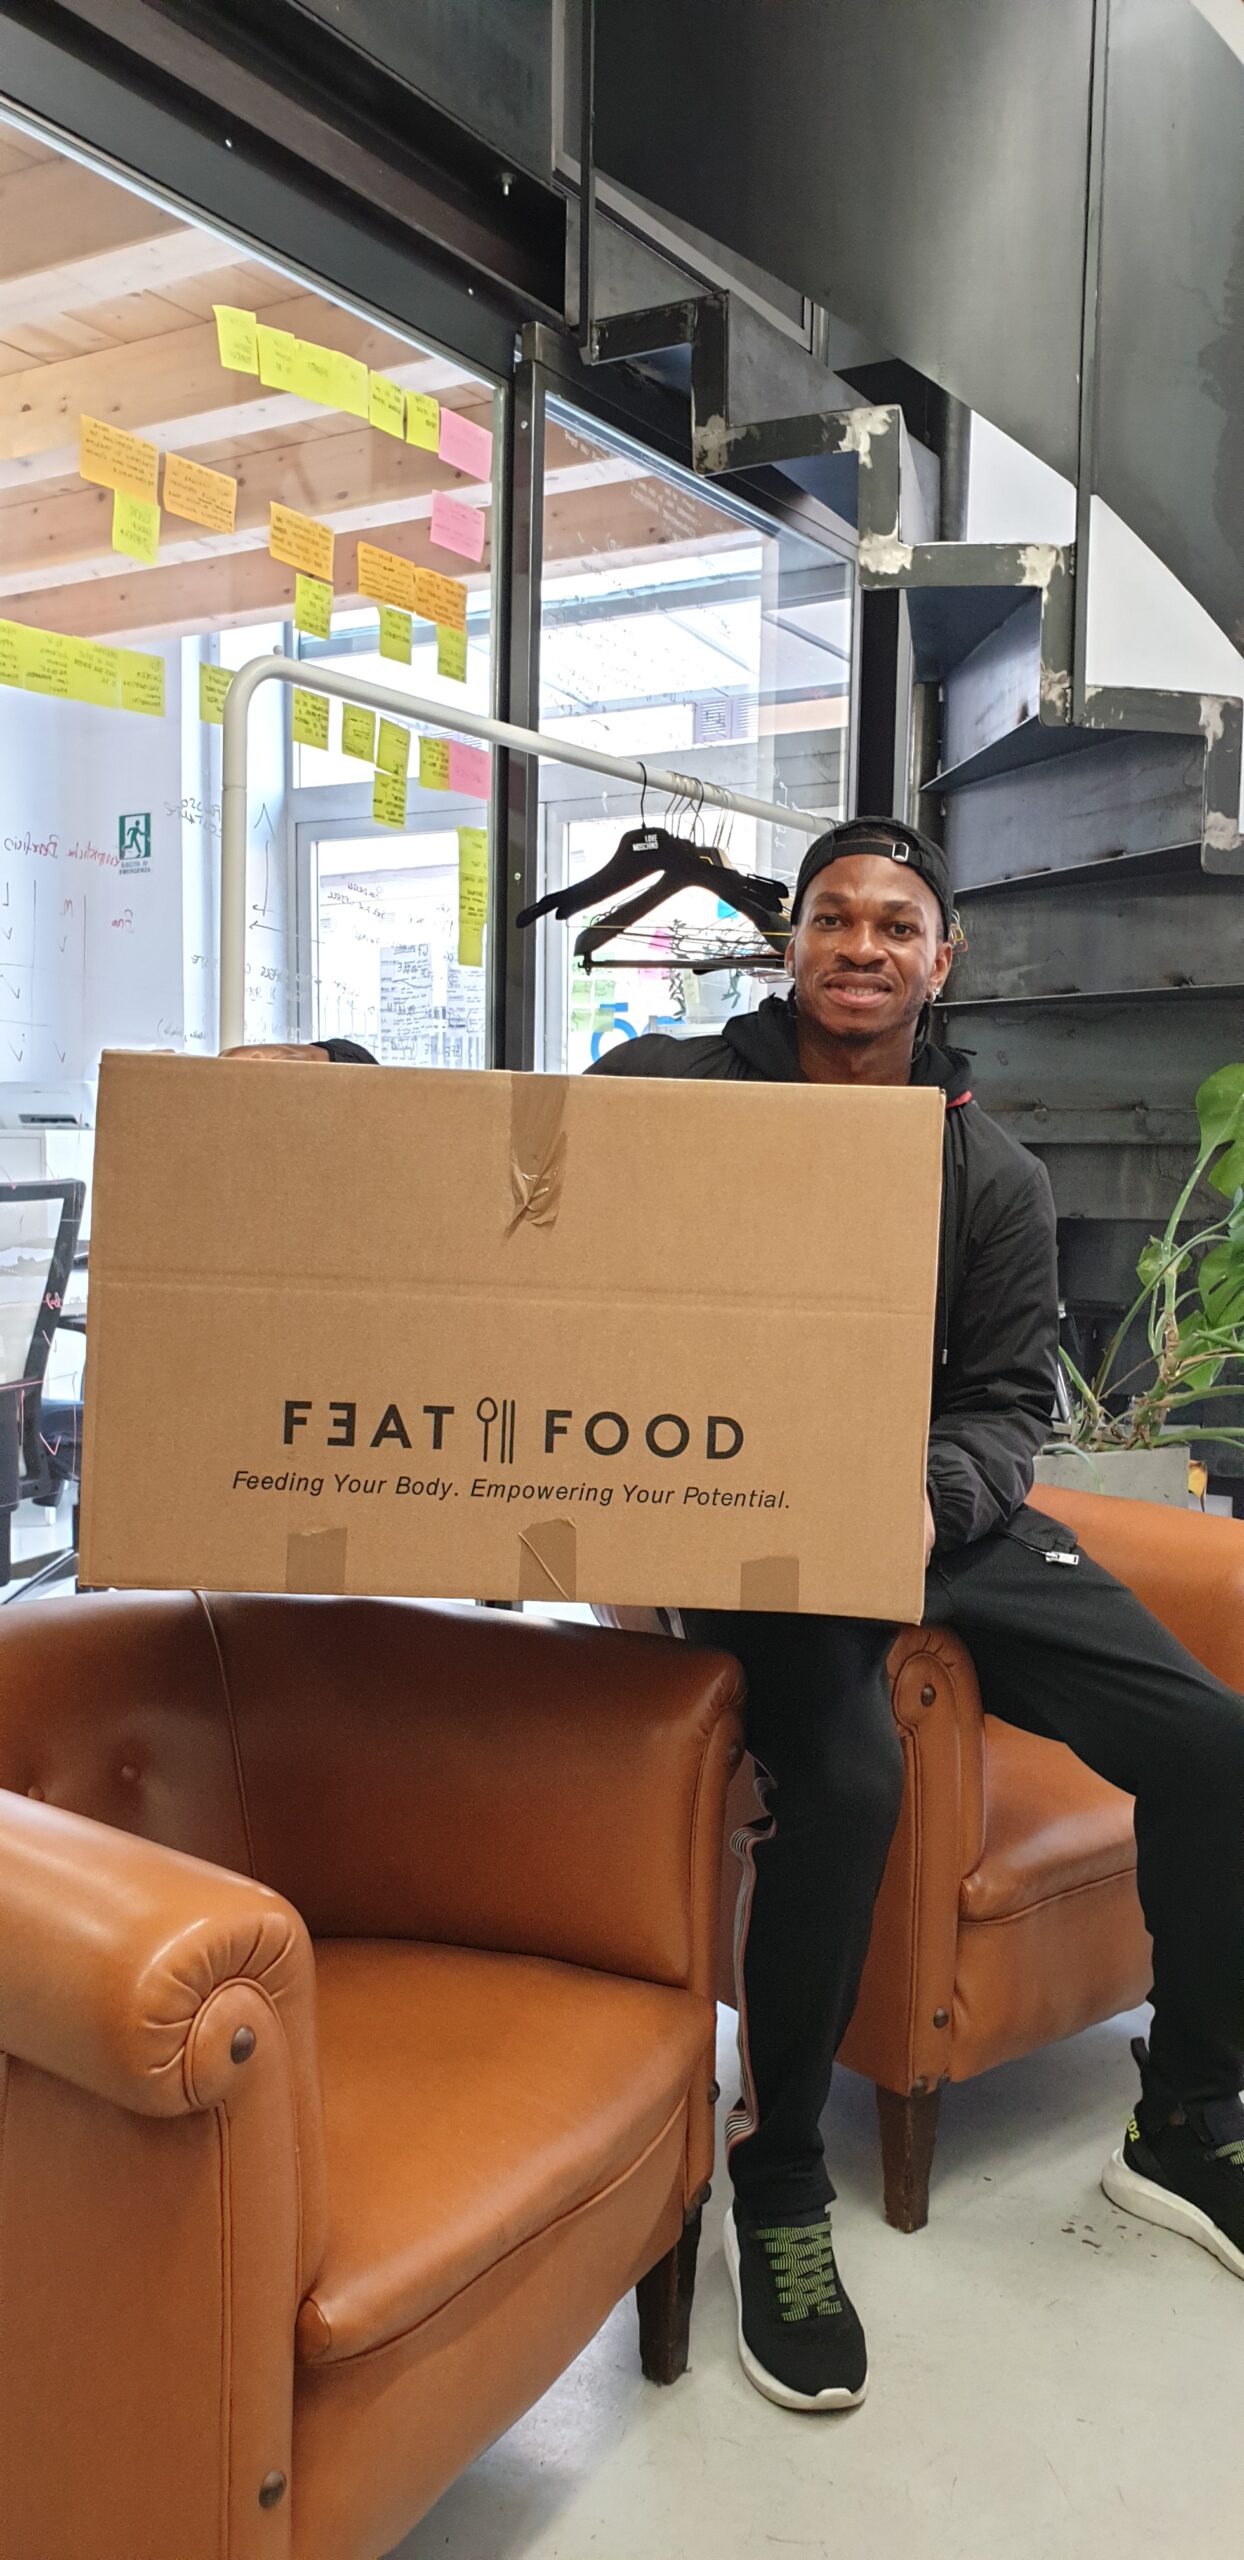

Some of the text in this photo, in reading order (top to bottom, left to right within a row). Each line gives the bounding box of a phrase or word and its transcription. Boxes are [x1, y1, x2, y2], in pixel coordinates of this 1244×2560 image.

[644, 834, 658, 843] LOVE
[544, 1409, 744, 1460] FOOD
[232, 1470, 793, 1509] Feeding Your Body. Empowering Your Potential.
